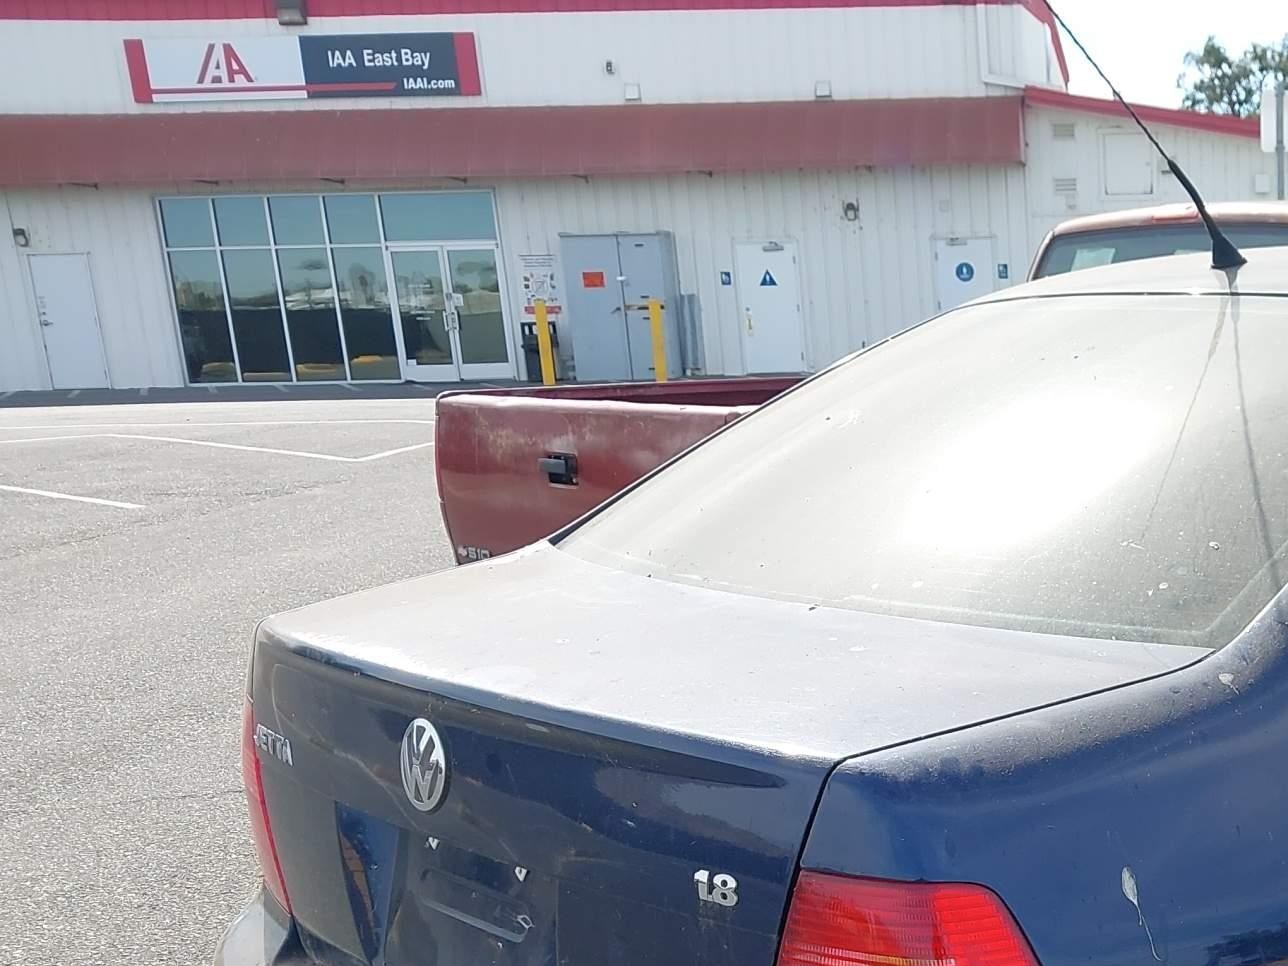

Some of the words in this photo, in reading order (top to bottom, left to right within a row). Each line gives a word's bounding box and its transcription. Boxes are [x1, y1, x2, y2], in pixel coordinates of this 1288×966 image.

[327, 49, 357, 68] IAA
[362, 48, 399, 67] East
[400, 47, 431, 70] Bay
[402, 77, 455, 90] IAAI.com
[253, 723, 293, 767] JETTA
